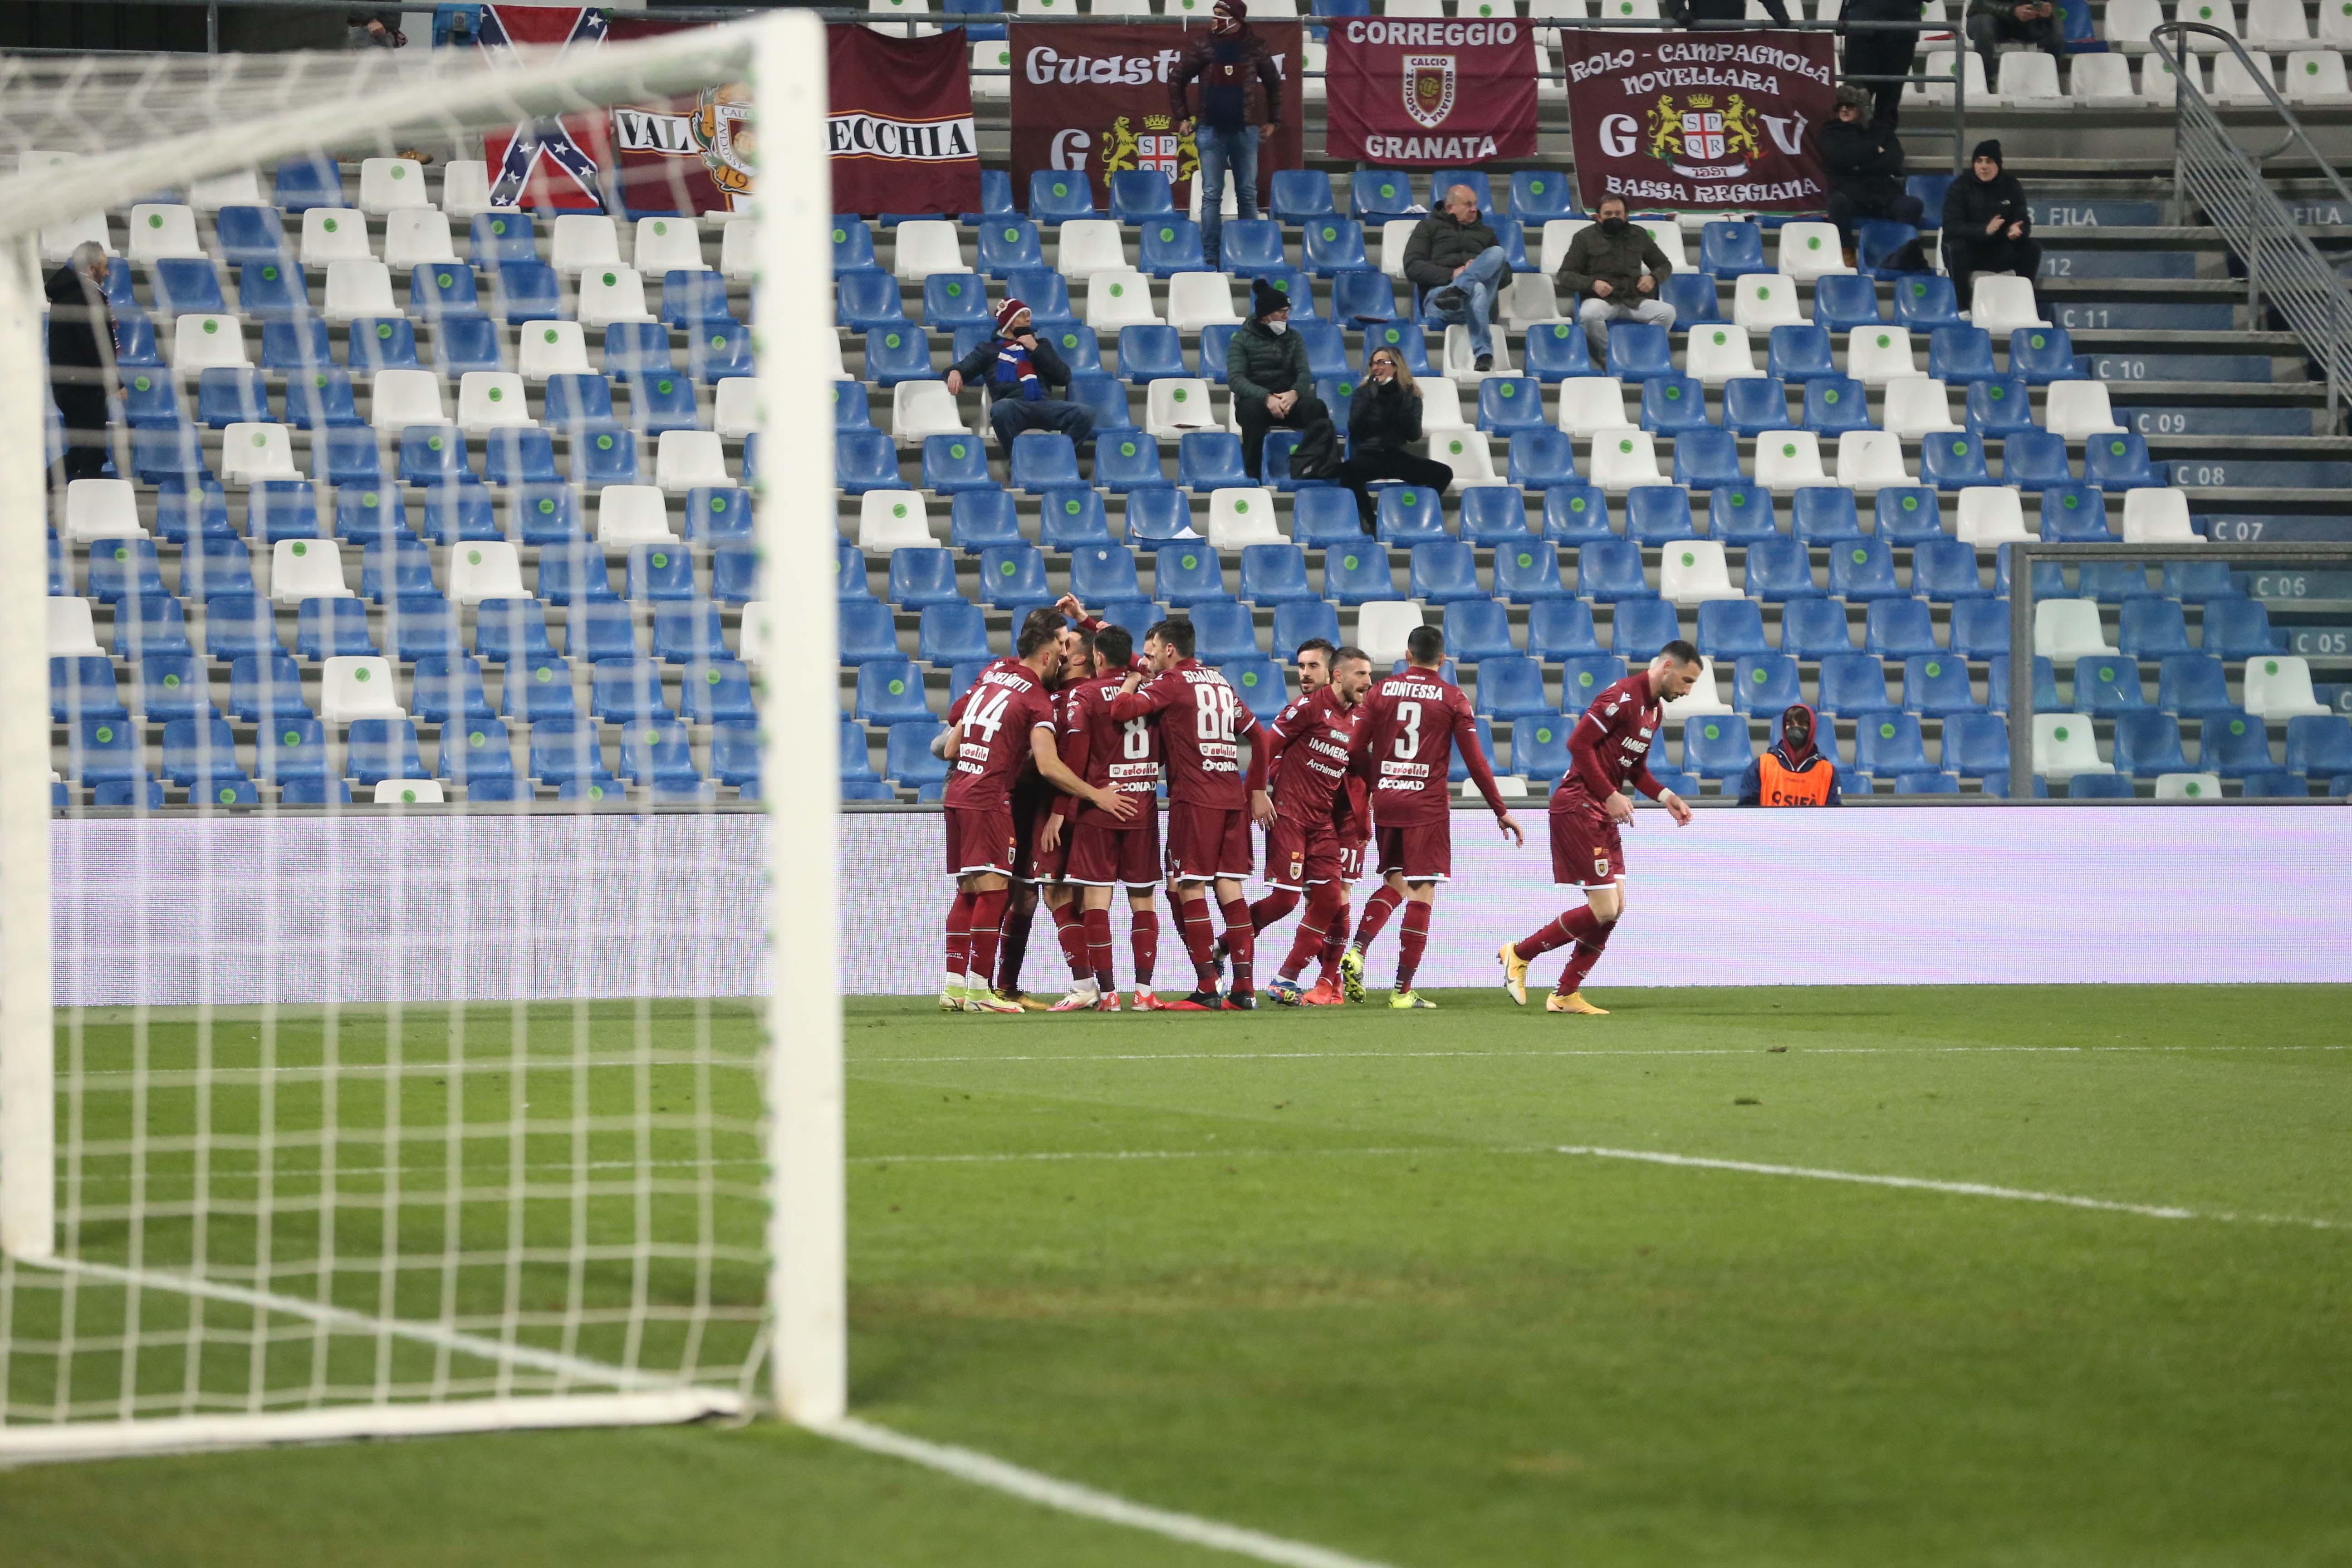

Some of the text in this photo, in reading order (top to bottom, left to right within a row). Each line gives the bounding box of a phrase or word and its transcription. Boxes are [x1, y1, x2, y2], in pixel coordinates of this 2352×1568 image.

[1347, 20, 1517, 46] CORREGGIO
[1411, 58, 1448, 67] CALCIO
[1569, 49, 1635, 83] ROLO
[1621, 67, 1779, 95] NOVELLARA
[1431, 71, 1453, 122] REGGIANA
[617, 112, 972, 155] VAL ECCHIA
[1599, 113, 1639, 157] G
[1760, 110, 1809, 155] V
[1365, 135, 1498, 159] GRANATA
[1692, 167, 1727, 177] 1991
[1606, 175, 1821, 204] BASSA REGGIANA
[2049, 207, 2098, 225] FILA
[2293, 206, 2342, 225] FILA
[2047, 258, 2072, 276] 12
[2063, 310, 2109, 328] C 11
[2099, 361, 2145, 379] C 10
[2138, 414, 2186, 432] C 09
[2177, 466, 2225, 485] C 08
[2215, 522, 2264, 540] C 07
[2257, 577, 2306, 596] C 06
[2297, 634, 2346, 653] C 05
[1381, 681, 1443, 701] CONTESSA
[962, 685, 1013, 743] 44
[1194, 684, 1236, 742] 88
[1123, 716, 1150, 760] 8
[1394, 701, 1422, 760] 3
[957, 760, 984, 775] ONAD
[1385, 779, 1425, 791] CONAD
[1339, 847, 1357, 873] 21
